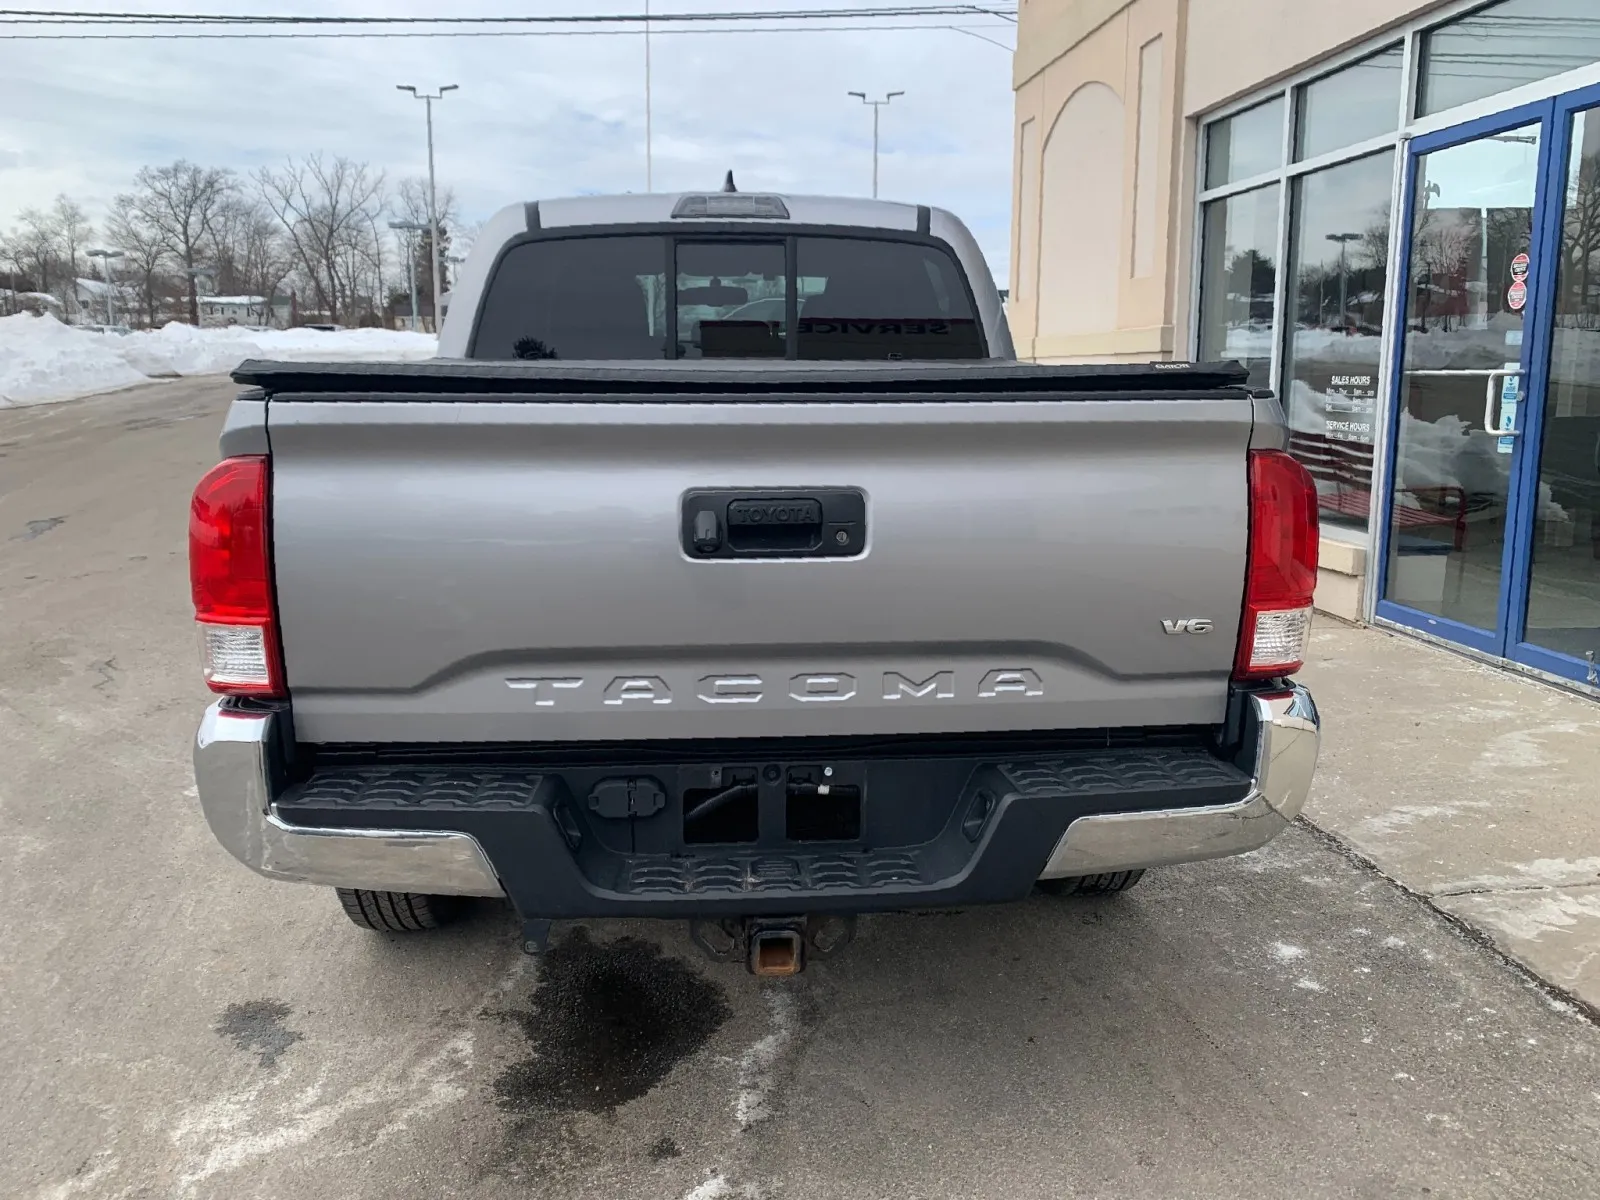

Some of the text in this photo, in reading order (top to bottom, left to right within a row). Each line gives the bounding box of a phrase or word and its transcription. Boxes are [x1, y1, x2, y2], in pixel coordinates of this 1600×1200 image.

[1331, 376, 1370, 385] SALES HOURS
[1326, 421, 1370, 432] SERVICE HOURS
[738, 504, 815, 522] TOYOTA
[1160, 618, 1214, 635] V6
[505, 668, 1044, 706] TACOMA
